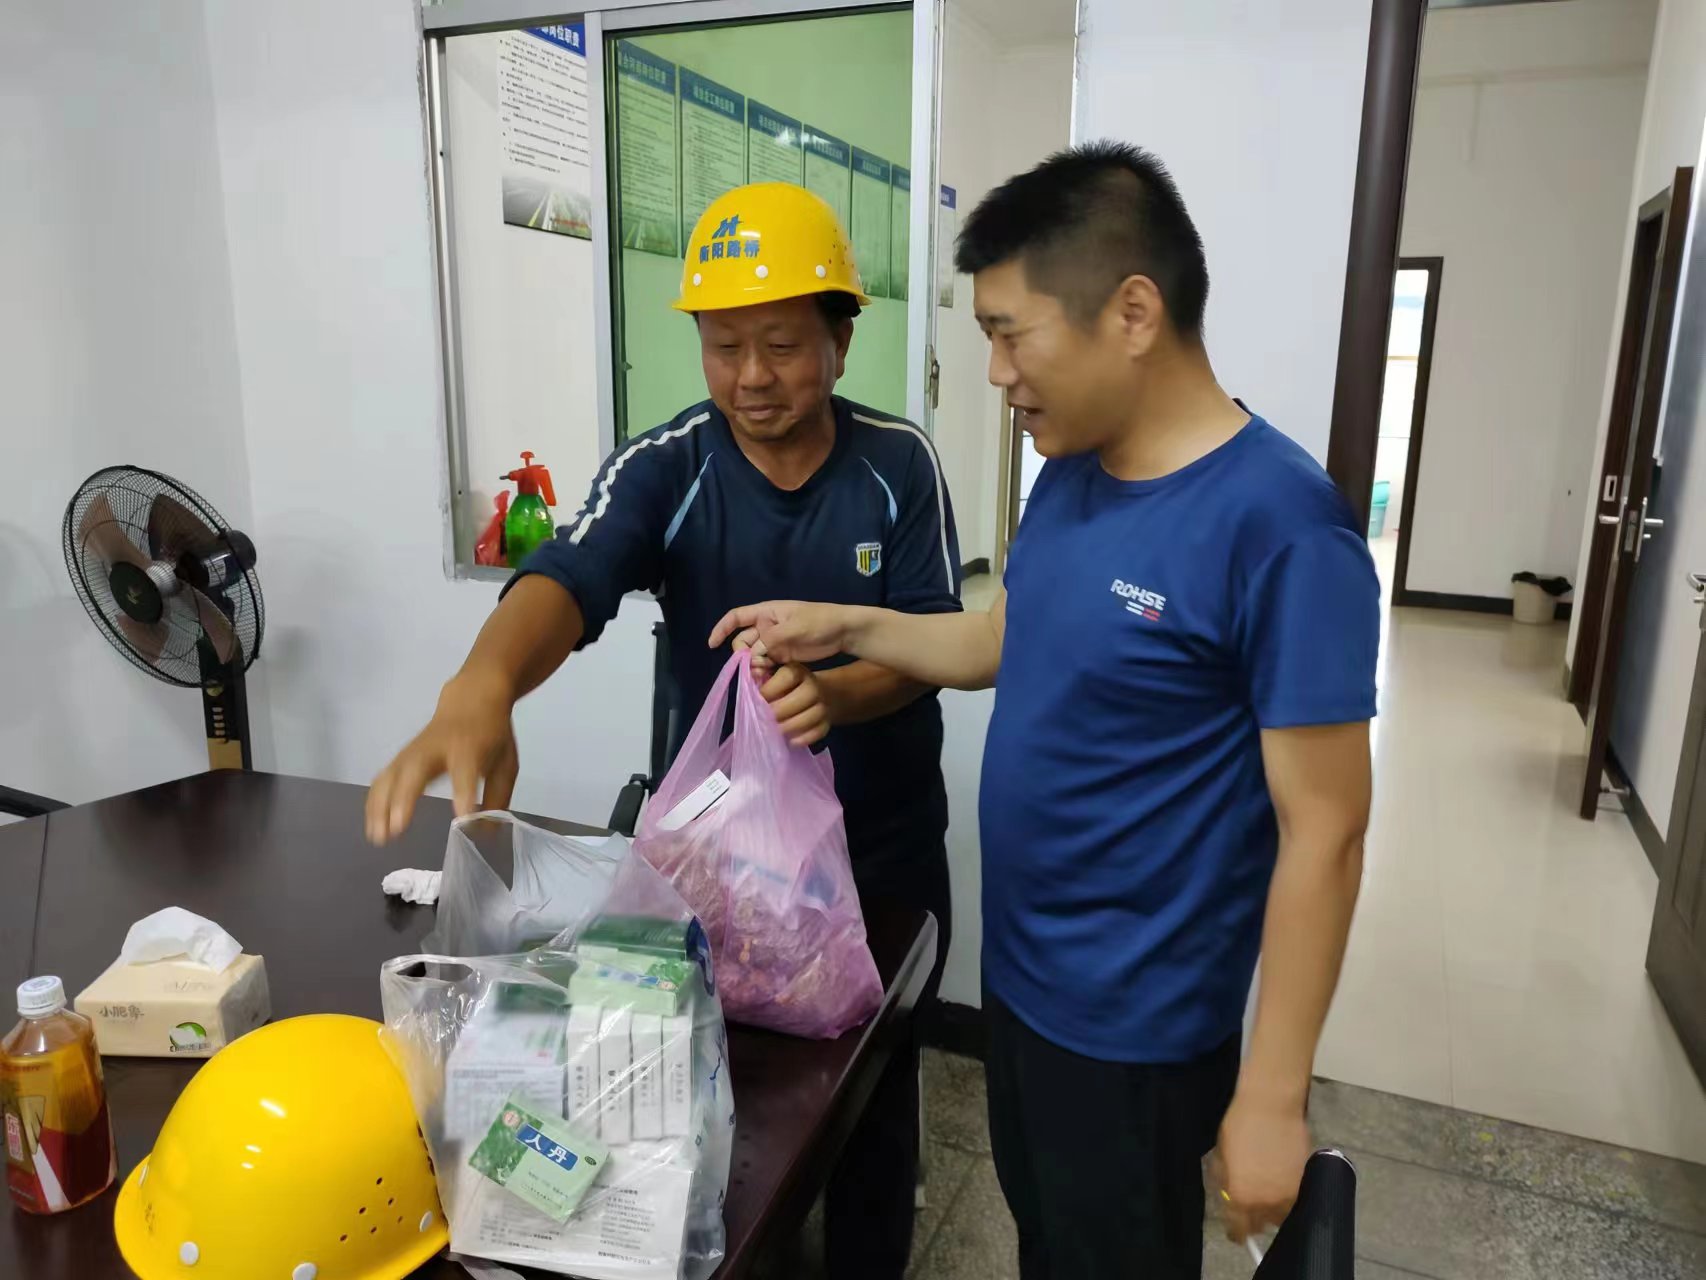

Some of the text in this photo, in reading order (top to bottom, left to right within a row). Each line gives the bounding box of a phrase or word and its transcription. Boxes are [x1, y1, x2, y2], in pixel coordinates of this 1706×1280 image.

[700, 240, 760, 264] 衡阳路桥
[1110, 578, 1166, 611] ROHSE
[525, 1132, 567, 1163] 人丹
